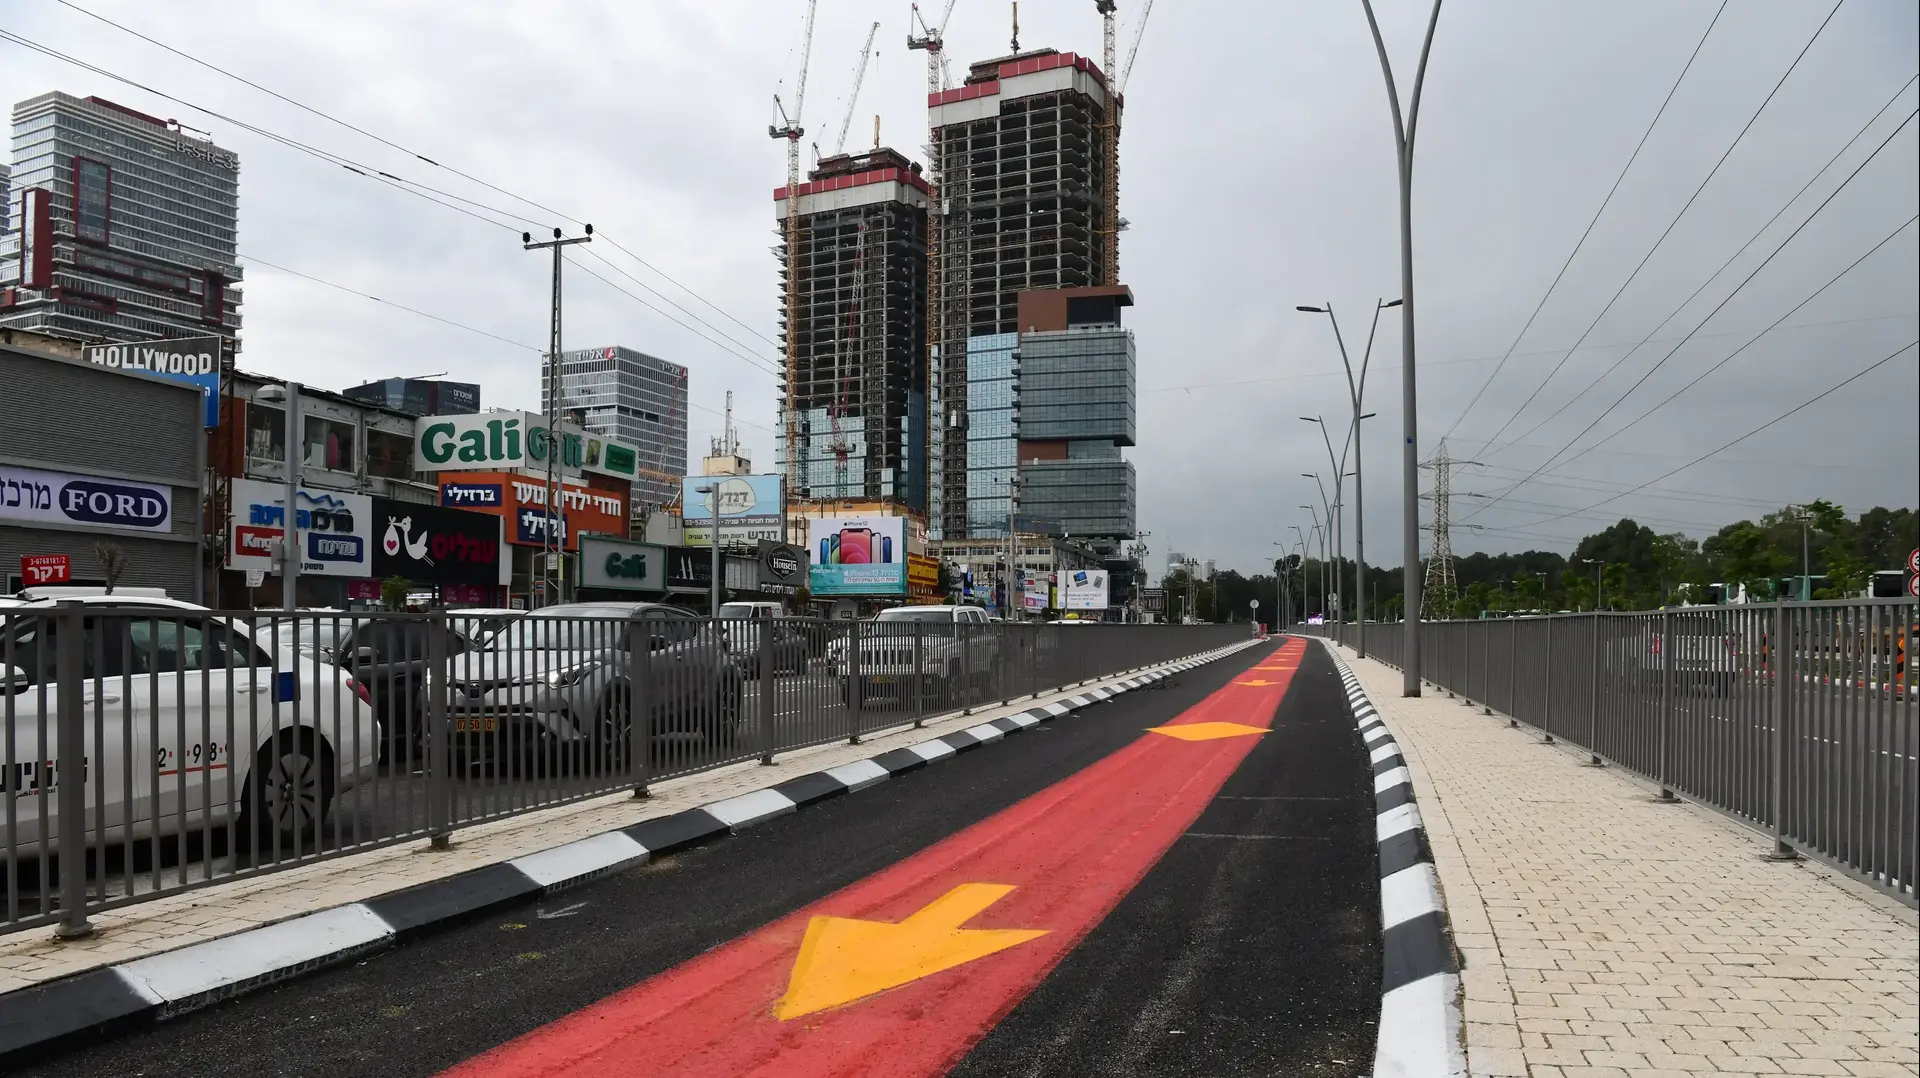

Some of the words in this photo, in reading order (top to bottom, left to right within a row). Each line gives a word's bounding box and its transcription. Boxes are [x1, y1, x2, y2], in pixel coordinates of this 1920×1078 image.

[223, 154, 234, 169] 3
[91, 346, 212, 376] HOLLYWOOD
[420, 418, 523, 463] Gali
[65, 488, 163, 519] FORD
[447, 486, 495, 503] ברזילי
[592, 495, 622, 517] חדרי
[249, 504, 310, 529] הינה
[27, 565, 66, 582] דקר
